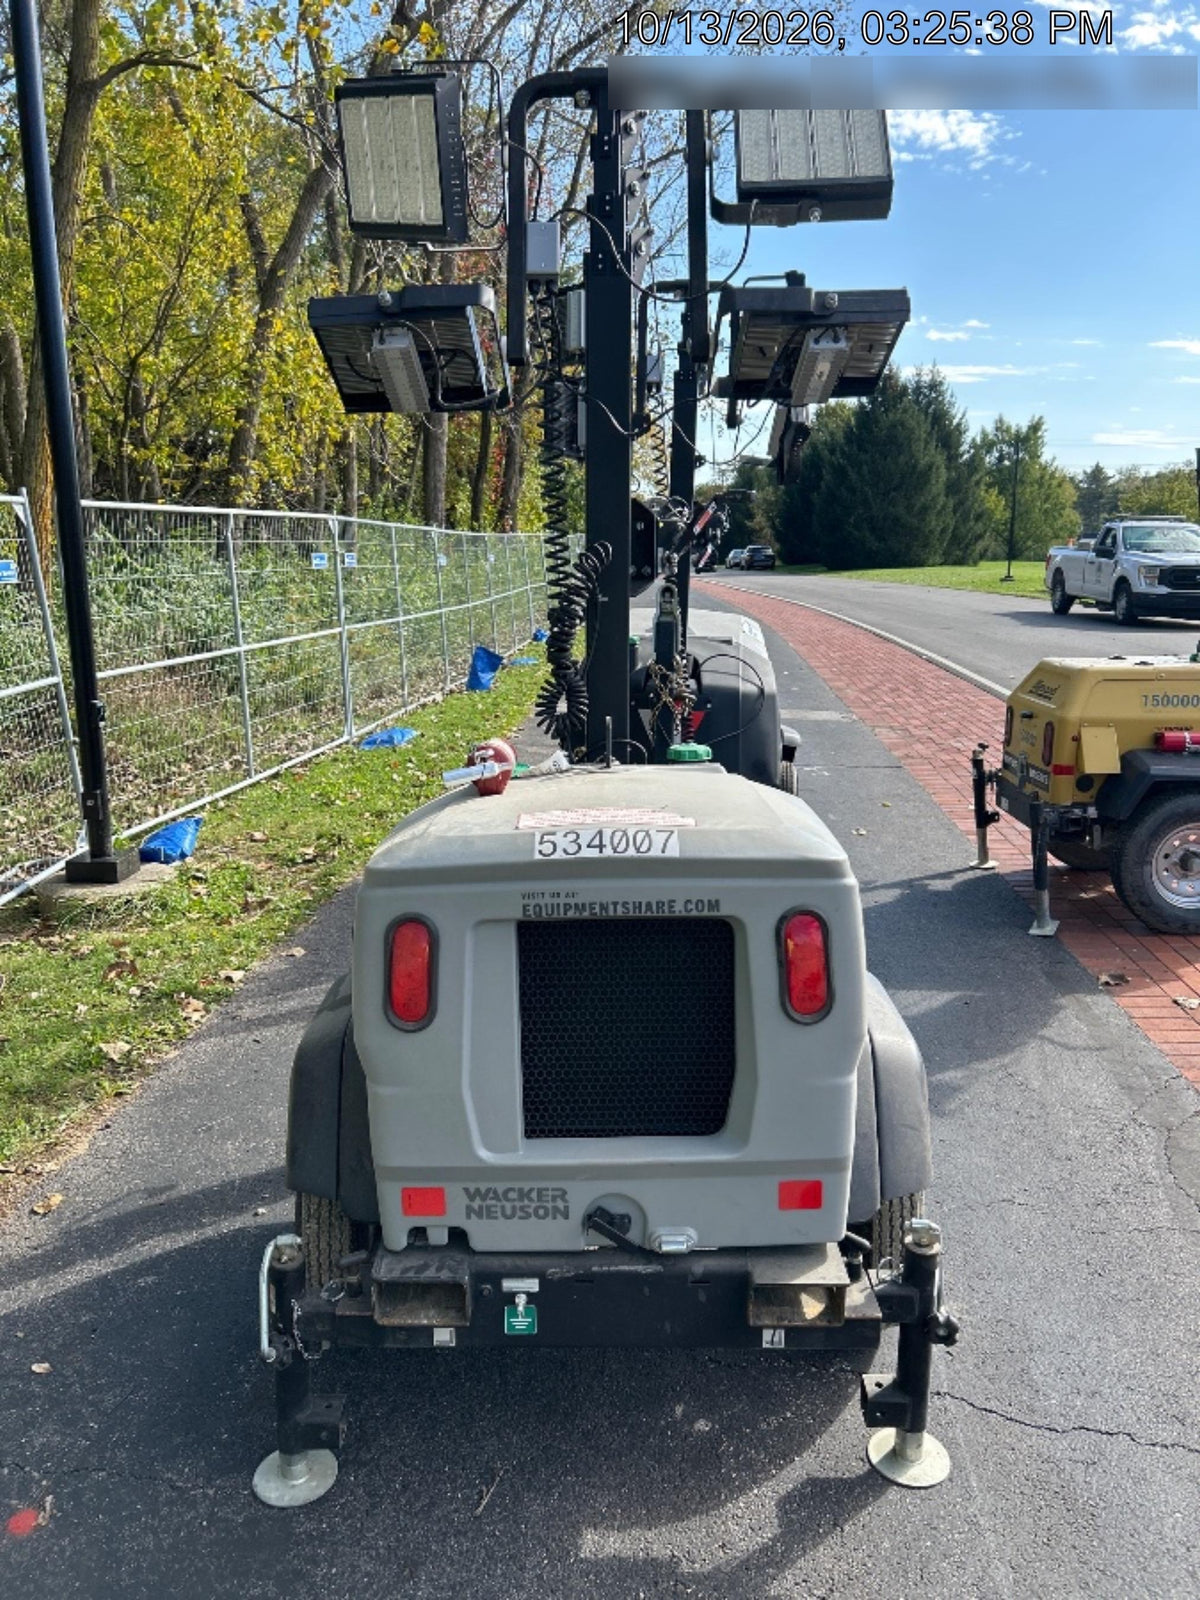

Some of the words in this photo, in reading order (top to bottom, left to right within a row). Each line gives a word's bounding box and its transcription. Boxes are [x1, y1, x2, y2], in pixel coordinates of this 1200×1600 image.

[538, 829, 674, 857] 534007
[522, 899, 720, 918] EQUIPMENTSHARE.COM
[462, 1187, 568, 1203] WACKER
[465, 1204, 569, 1220] NEUSON
